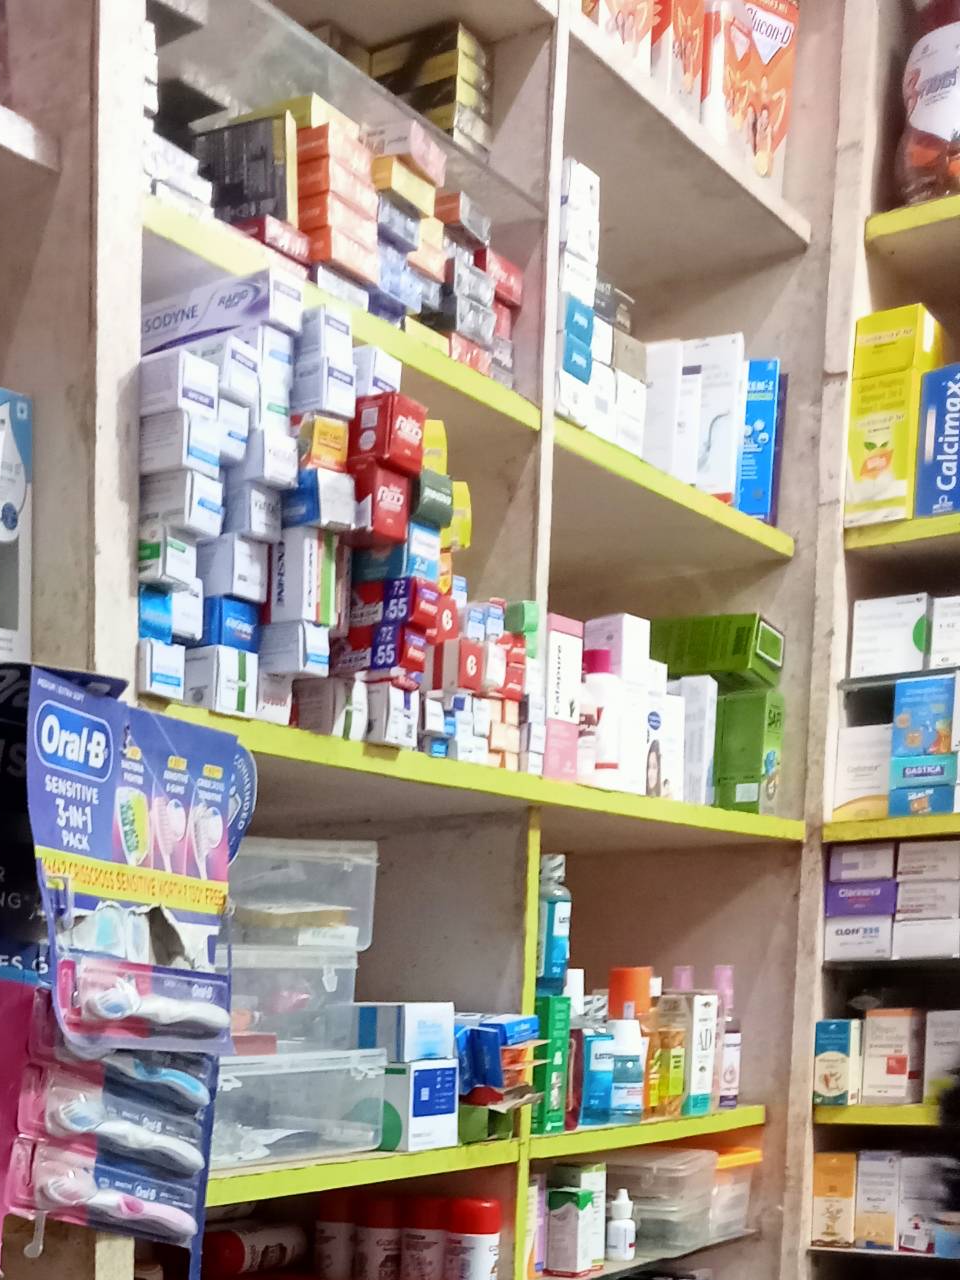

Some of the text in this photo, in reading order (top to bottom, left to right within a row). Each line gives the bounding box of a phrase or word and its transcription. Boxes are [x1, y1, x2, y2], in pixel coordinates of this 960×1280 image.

[388, 597, 409, 620] 55
[375, 645, 396, 666] 55
[41, 714, 108, 769] Oral-B
[44, 774, 99, 805] SENSITIVE
[55, 798, 93, 833] 3-IN-1
[62, 831, 91, 851] PACK
